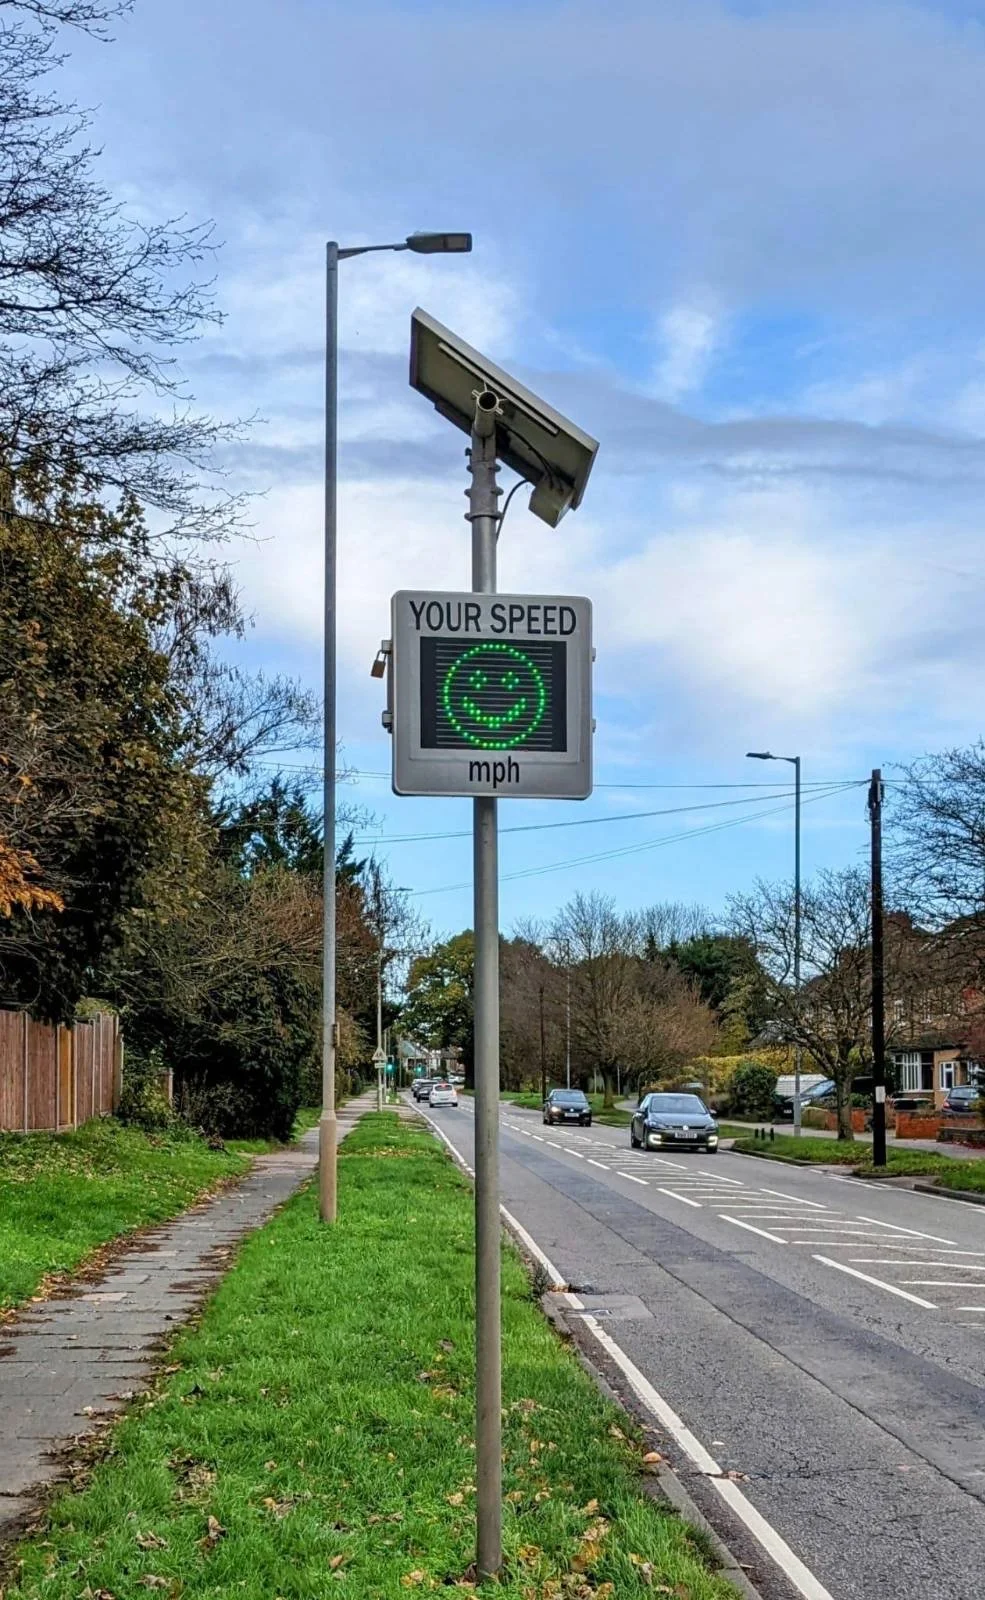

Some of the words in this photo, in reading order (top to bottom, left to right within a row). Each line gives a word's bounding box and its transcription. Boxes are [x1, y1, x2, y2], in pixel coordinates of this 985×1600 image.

[409, 601, 481, 633] YOUR
[490, 604, 577, 635] SPEED
[469, 756, 520, 789] mph
